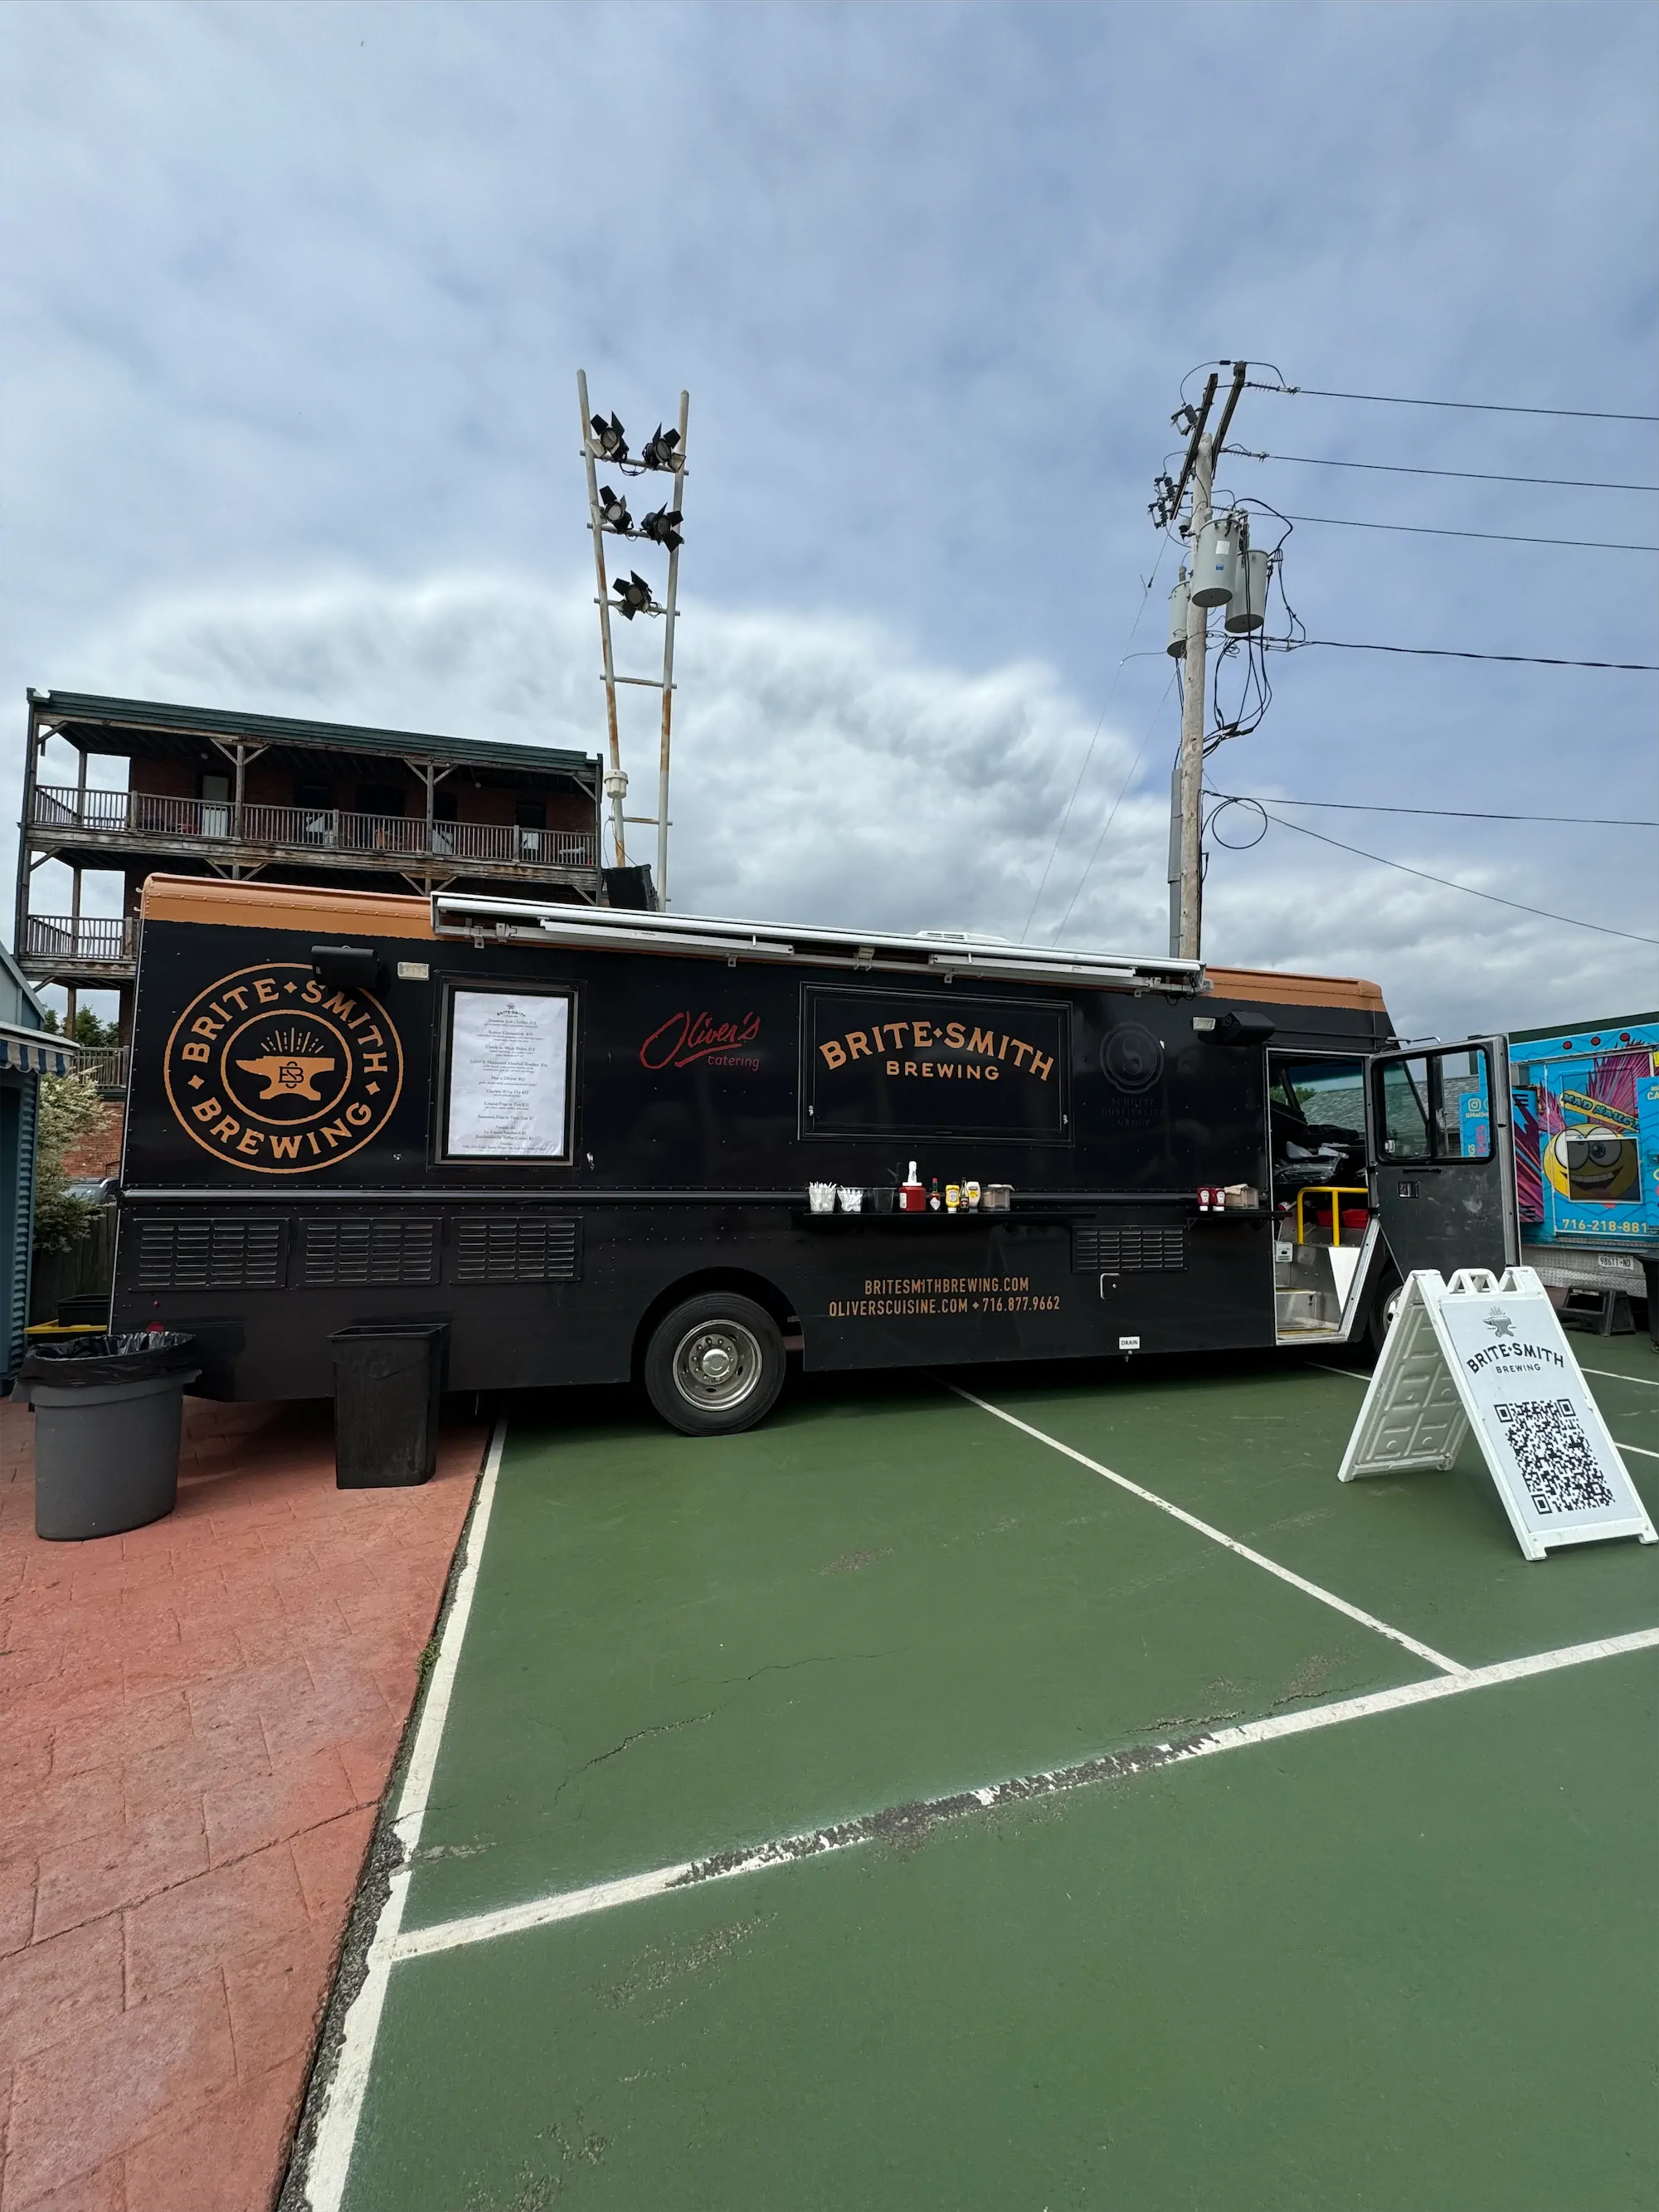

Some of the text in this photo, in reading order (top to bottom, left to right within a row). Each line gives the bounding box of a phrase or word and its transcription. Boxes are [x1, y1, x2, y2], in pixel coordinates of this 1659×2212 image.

[182, 977, 389, 1074] BRITE SMITH
[640, 1011, 761, 1069] Oliver's
[819, 1021, 1054, 1082] BRITE SMITH
[707, 1054, 761, 1072] catering
[886, 1060, 1000, 1081] BREWING
[1561, 1093, 1593, 1111] MAD
[192, 1100, 372, 1159] BREWING
[864, 1276, 1029, 1295] BRITESMITHBREWING.COM
[829, 1295, 1061, 1317] OLIVERSCUISINE.COM 716.877.9662
[1466, 1343, 1564, 1374] BRITE SMITH
[1496, 1363, 1541, 1374] BREWING
